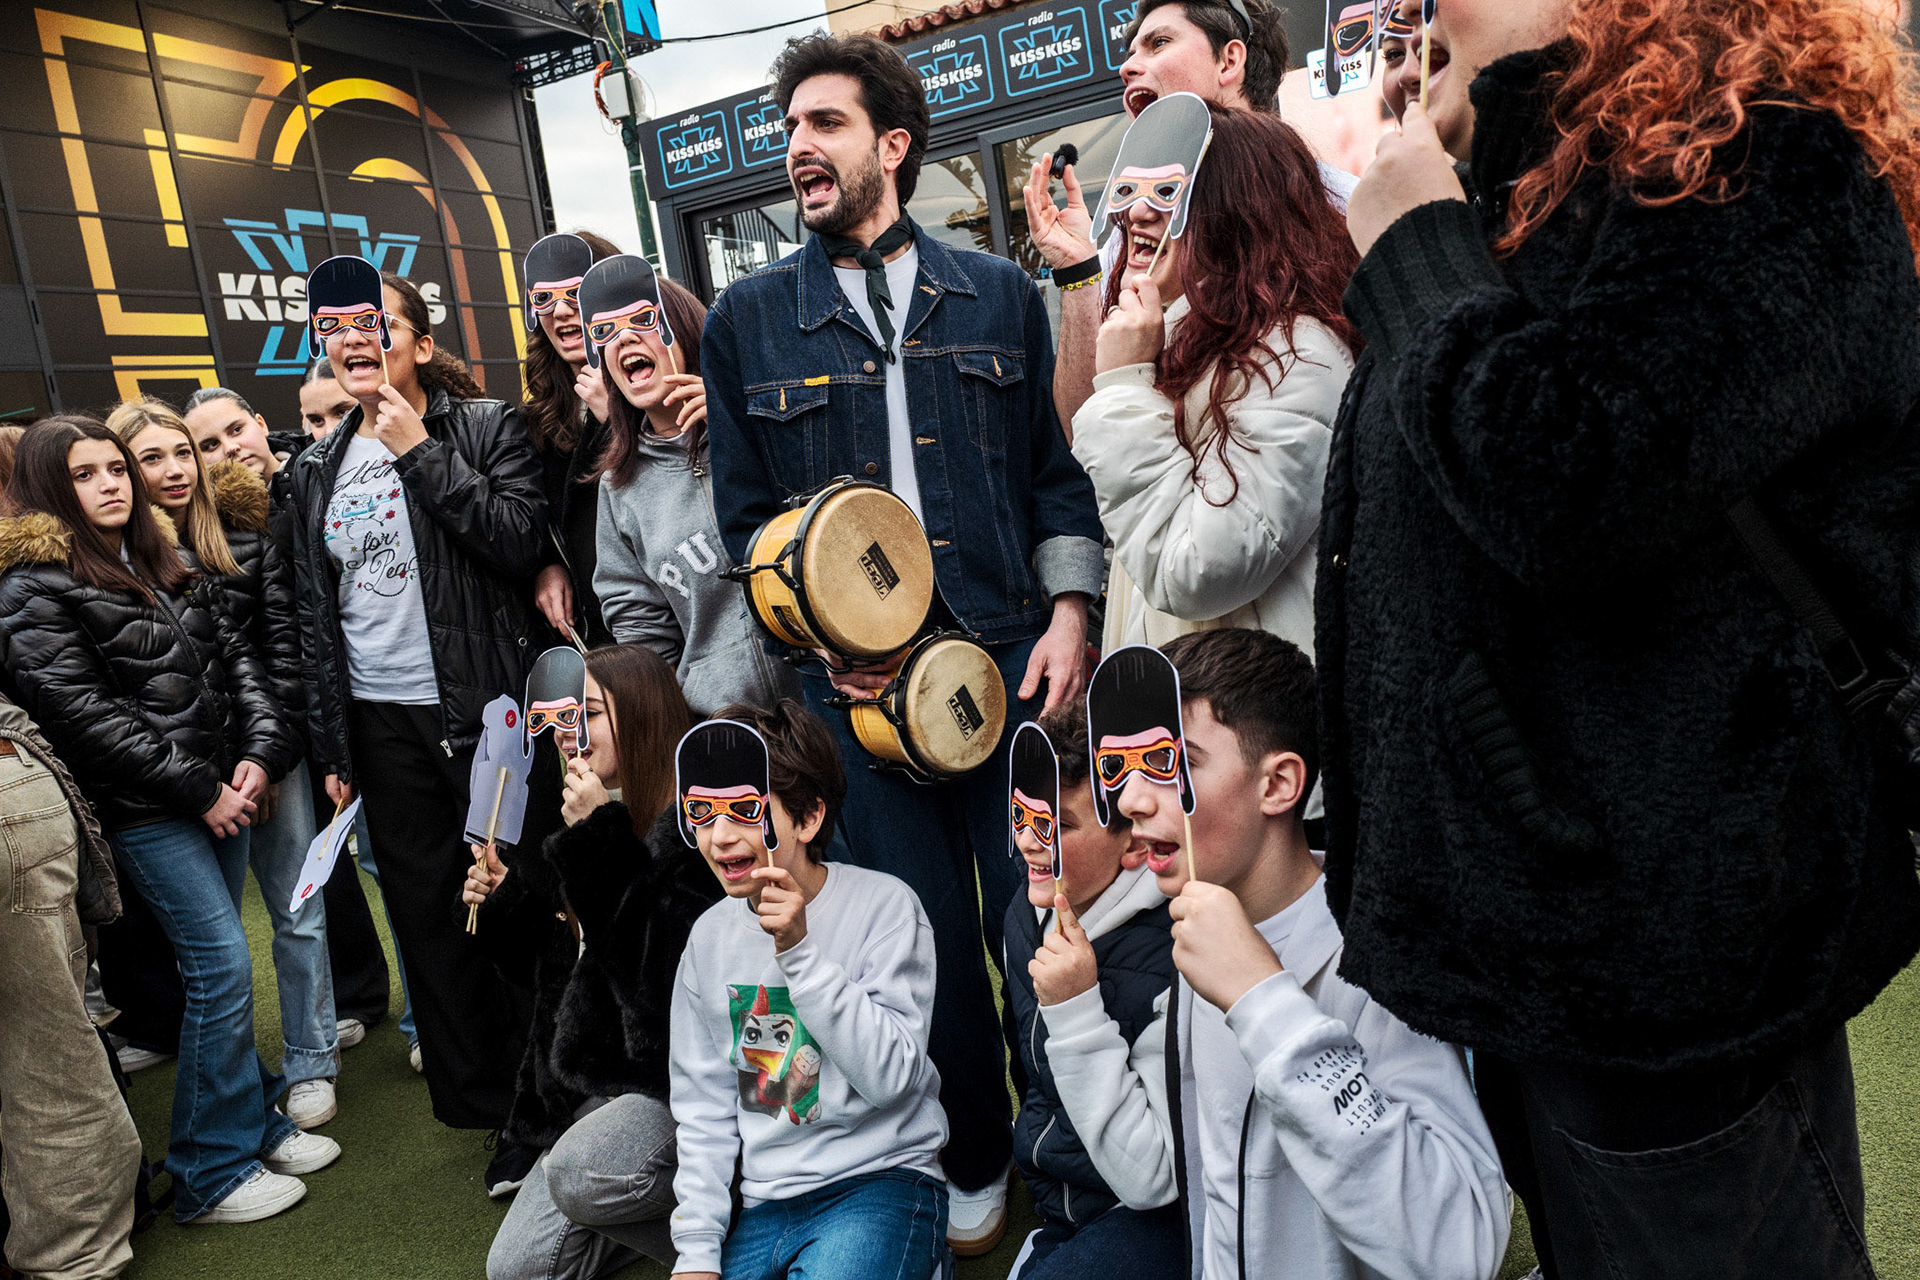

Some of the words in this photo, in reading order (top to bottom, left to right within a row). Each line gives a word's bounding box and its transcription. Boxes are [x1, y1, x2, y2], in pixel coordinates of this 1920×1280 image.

[1027, 10, 1054, 27] radio
[932, 38, 956, 54] radio
[1009, 36, 1082, 68] KISSKISS
[758, 89, 775, 104] rad
[679, 114, 700, 128] radio
[744, 118, 787, 141] KISSK
[666, 137, 723, 164] KISSKISS
[345, 530, 396, 570] for
